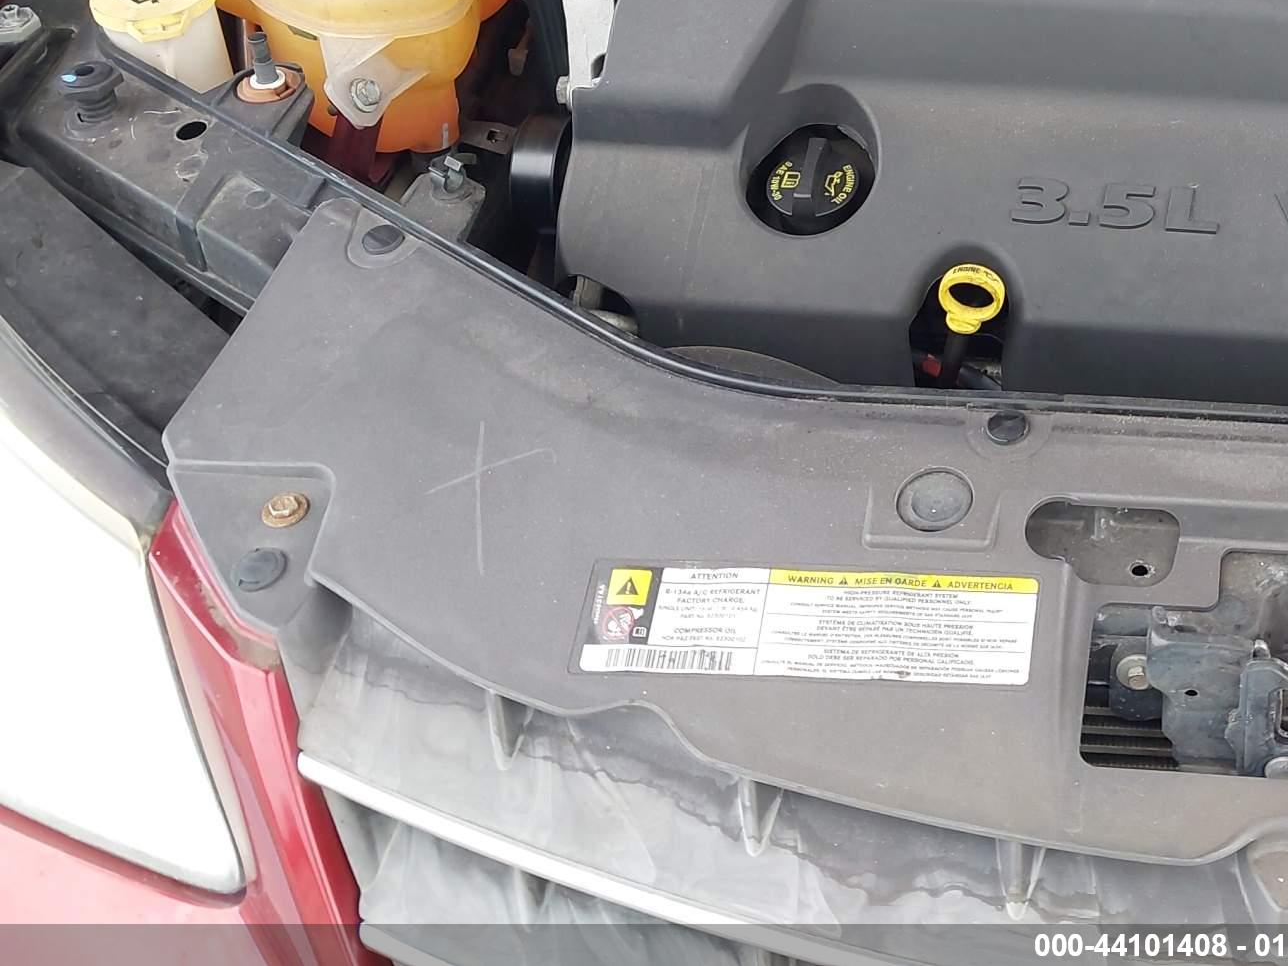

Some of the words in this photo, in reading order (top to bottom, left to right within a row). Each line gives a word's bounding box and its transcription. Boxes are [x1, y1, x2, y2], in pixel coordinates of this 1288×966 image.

[842, 164, 856, 193] ENGINE
[831, 192, 847, 204] OIL
[1010, 177, 1220, 235] 3.5L
[690, 572, 739, 580] ATTENTION
[787, 575, 834, 585] WARNING
[855, 577, 878, 585] MISE
[879, 577, 893, 585] EN
[894, 577, 928, 587] GARDE
[946, 580, 1014, 590] ADVERTENCIA
[674, 626, 723, 634] COMPRESSOR
